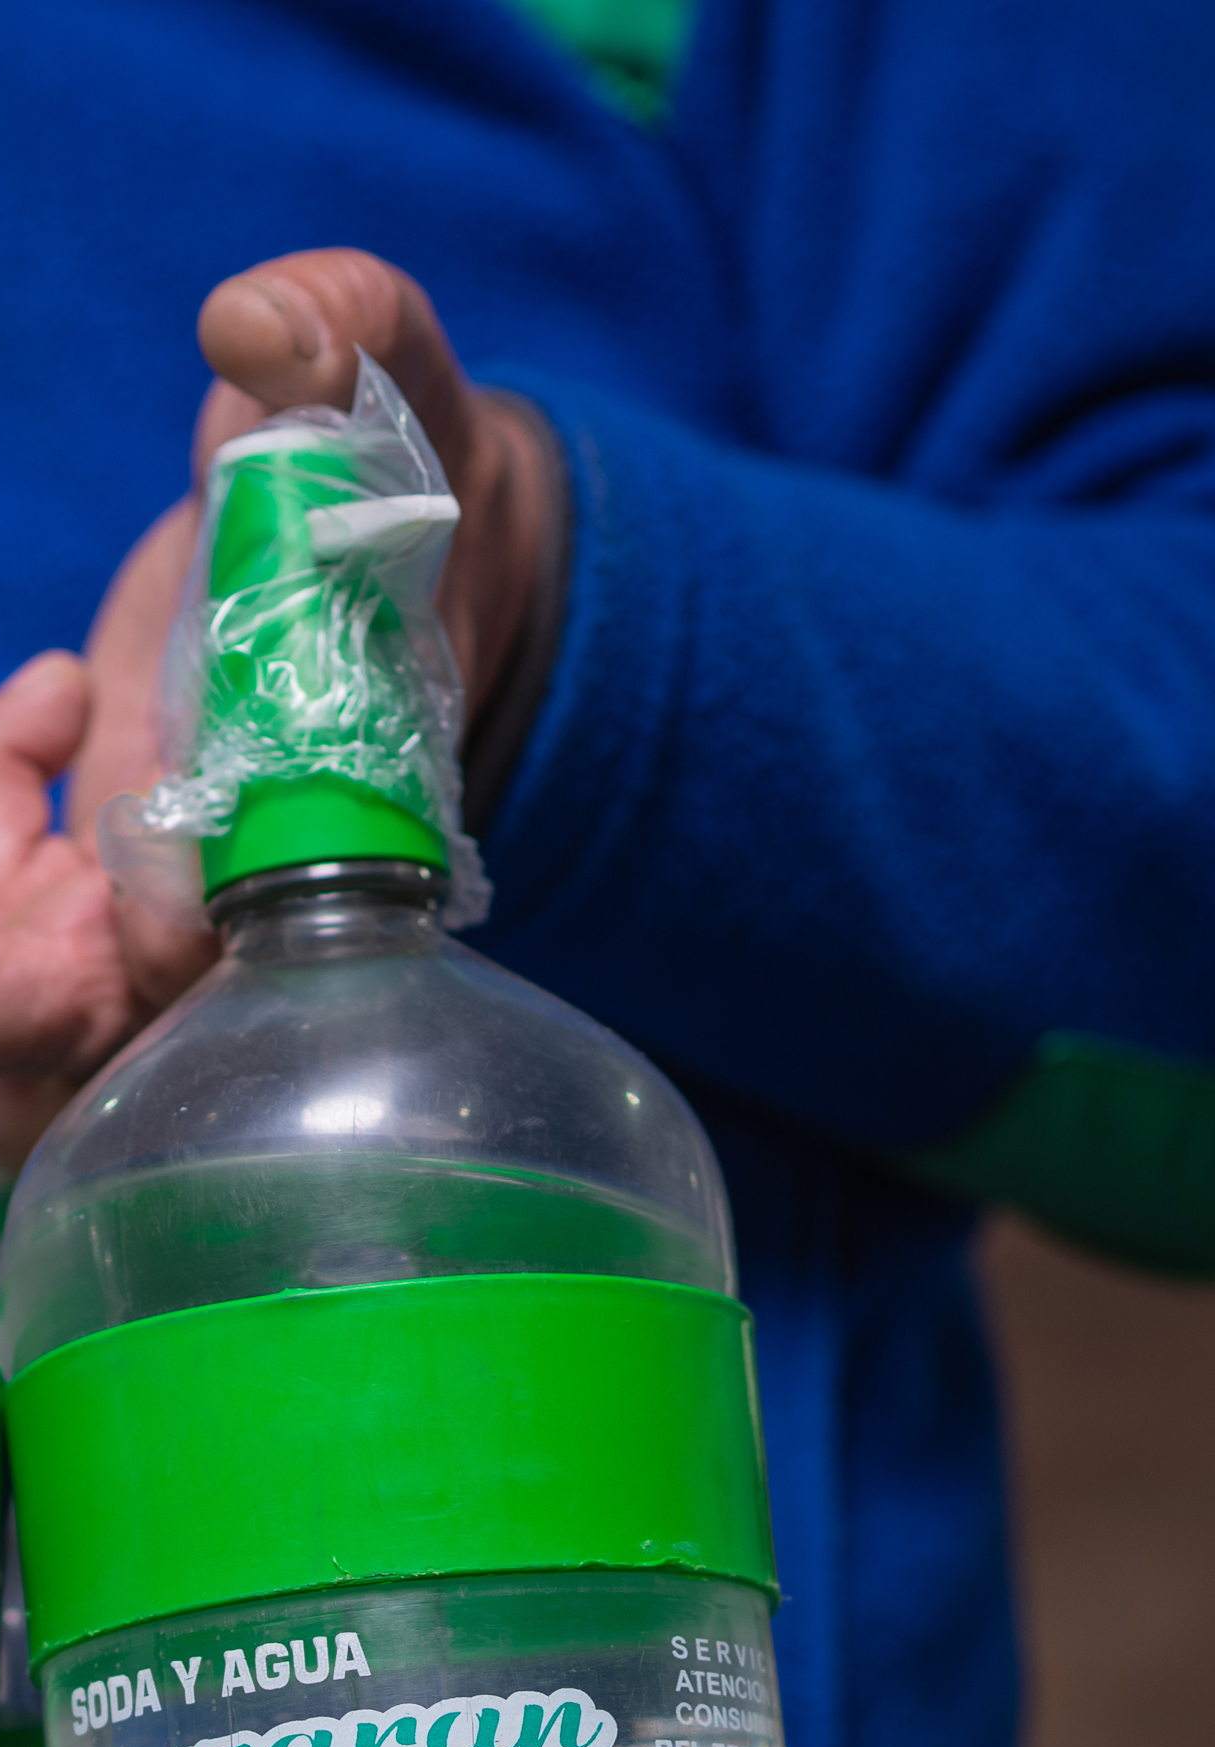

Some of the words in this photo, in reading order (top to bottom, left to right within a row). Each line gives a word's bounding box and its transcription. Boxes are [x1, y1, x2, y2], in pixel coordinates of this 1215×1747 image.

[71, 1668, 162, 1736] SODA
[170, 1656, 202, 1705] Y
[221, 1631, 372, 1698] AGUA
